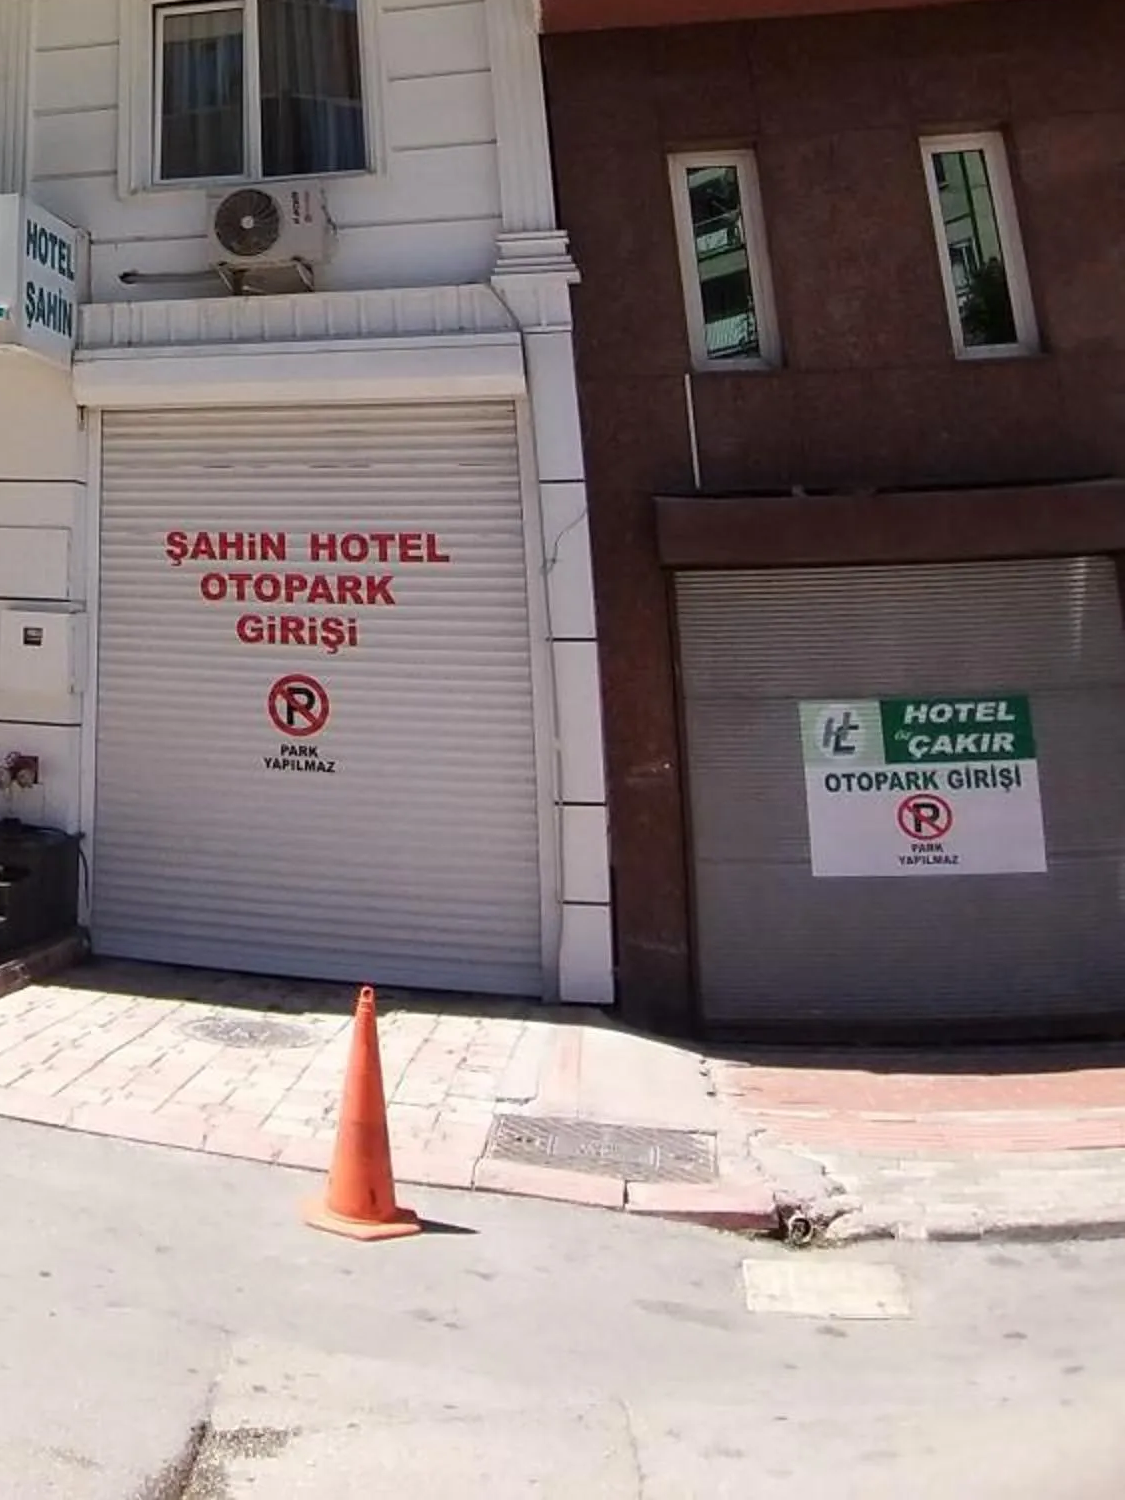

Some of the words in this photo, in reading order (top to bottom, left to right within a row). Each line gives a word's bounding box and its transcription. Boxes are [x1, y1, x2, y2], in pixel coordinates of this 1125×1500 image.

[26, 218, 75, 282] HOTEL
[25, 281, 74, 340] ŞAHİN
[310, 532, 450, 563] HOTEL
[200, 573, 395, 605] OTOPARK
[903, 701, 1016, 725] HOTEL
[280, 744, 318, 758] PARK
[908, 733, 1016, 759] ÇAKIR
[263, 757, 336, 773] YAPILMAZ
[825, 771, 940, 793] OTOPARK
[947, 764, 1022, 793] GİRİŞİ
[911, 843, 944, 853] PARK
